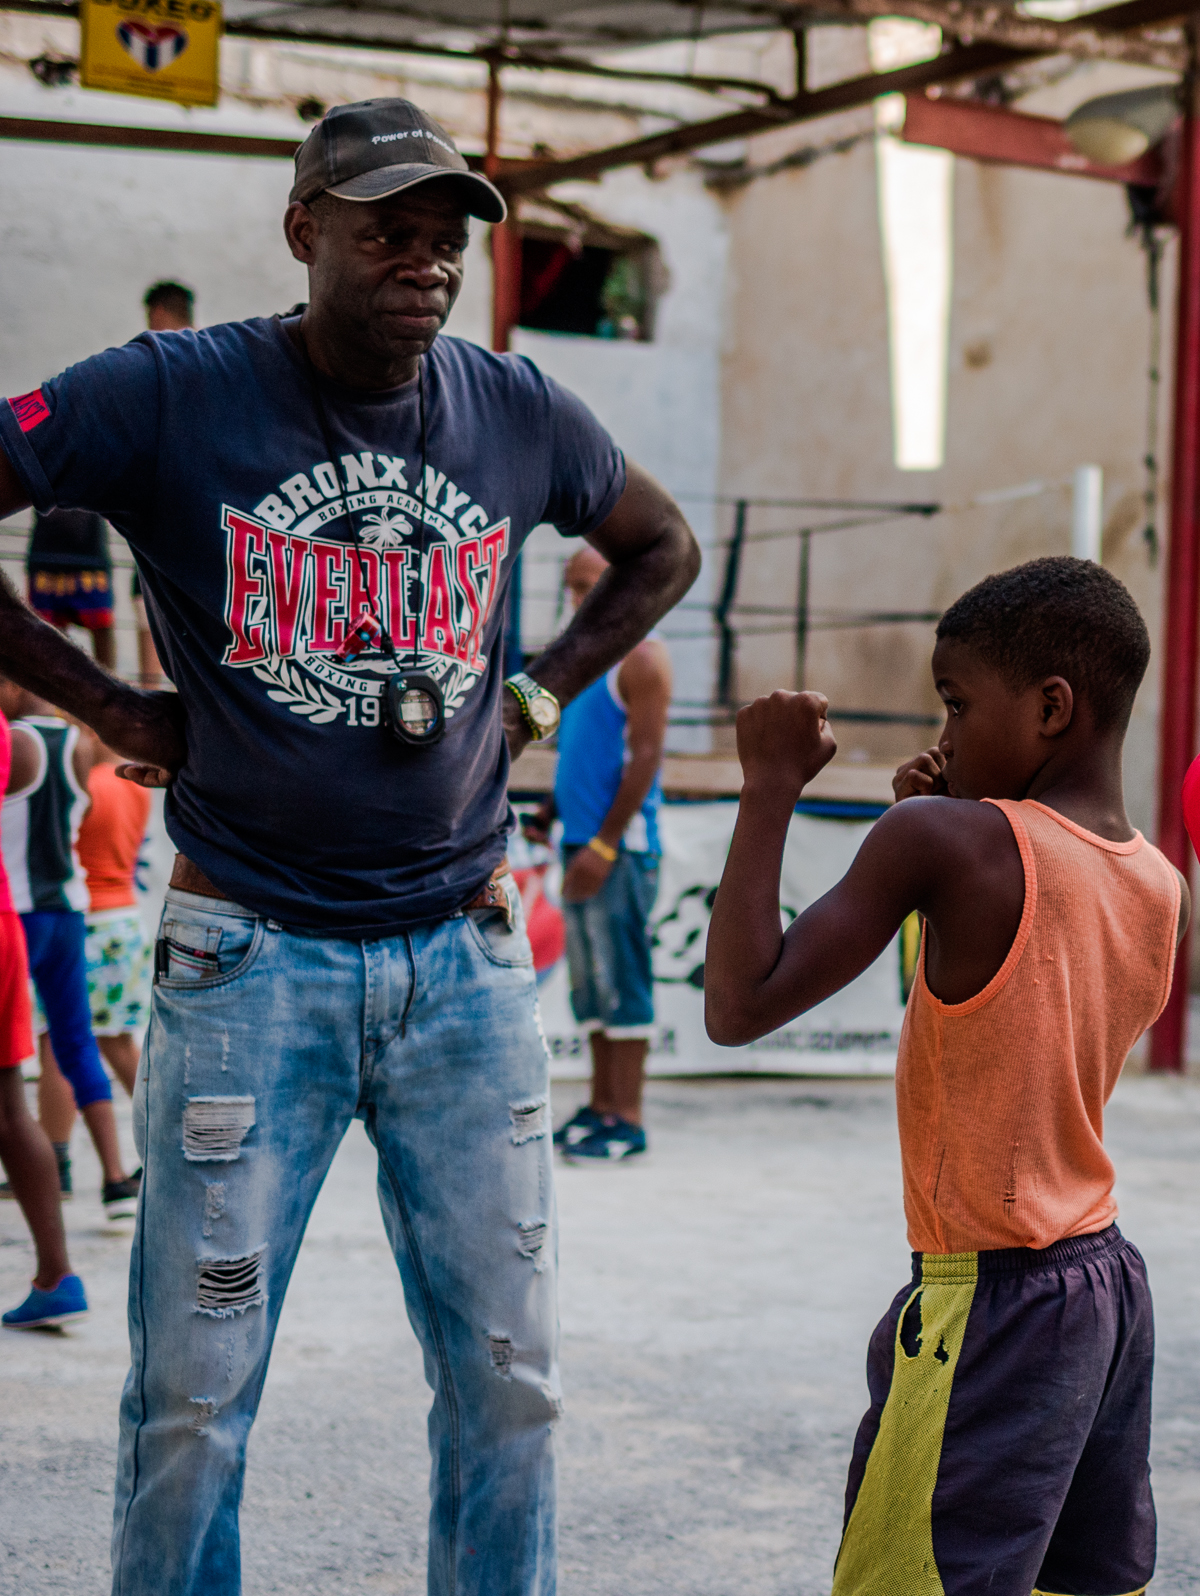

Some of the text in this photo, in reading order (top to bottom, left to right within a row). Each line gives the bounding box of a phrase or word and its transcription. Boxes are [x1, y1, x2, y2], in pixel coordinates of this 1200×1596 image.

[92, 0, 216, 21] OXEO
[372, 129, 423, 145] Power of
[253, 451, 490, 538] BRONX NYC
[318, 493, 447, 529] BOXING ACADMY
[221, 503, 511, 674] EVERLAST
[304, 655, 368, 693] BOXING
